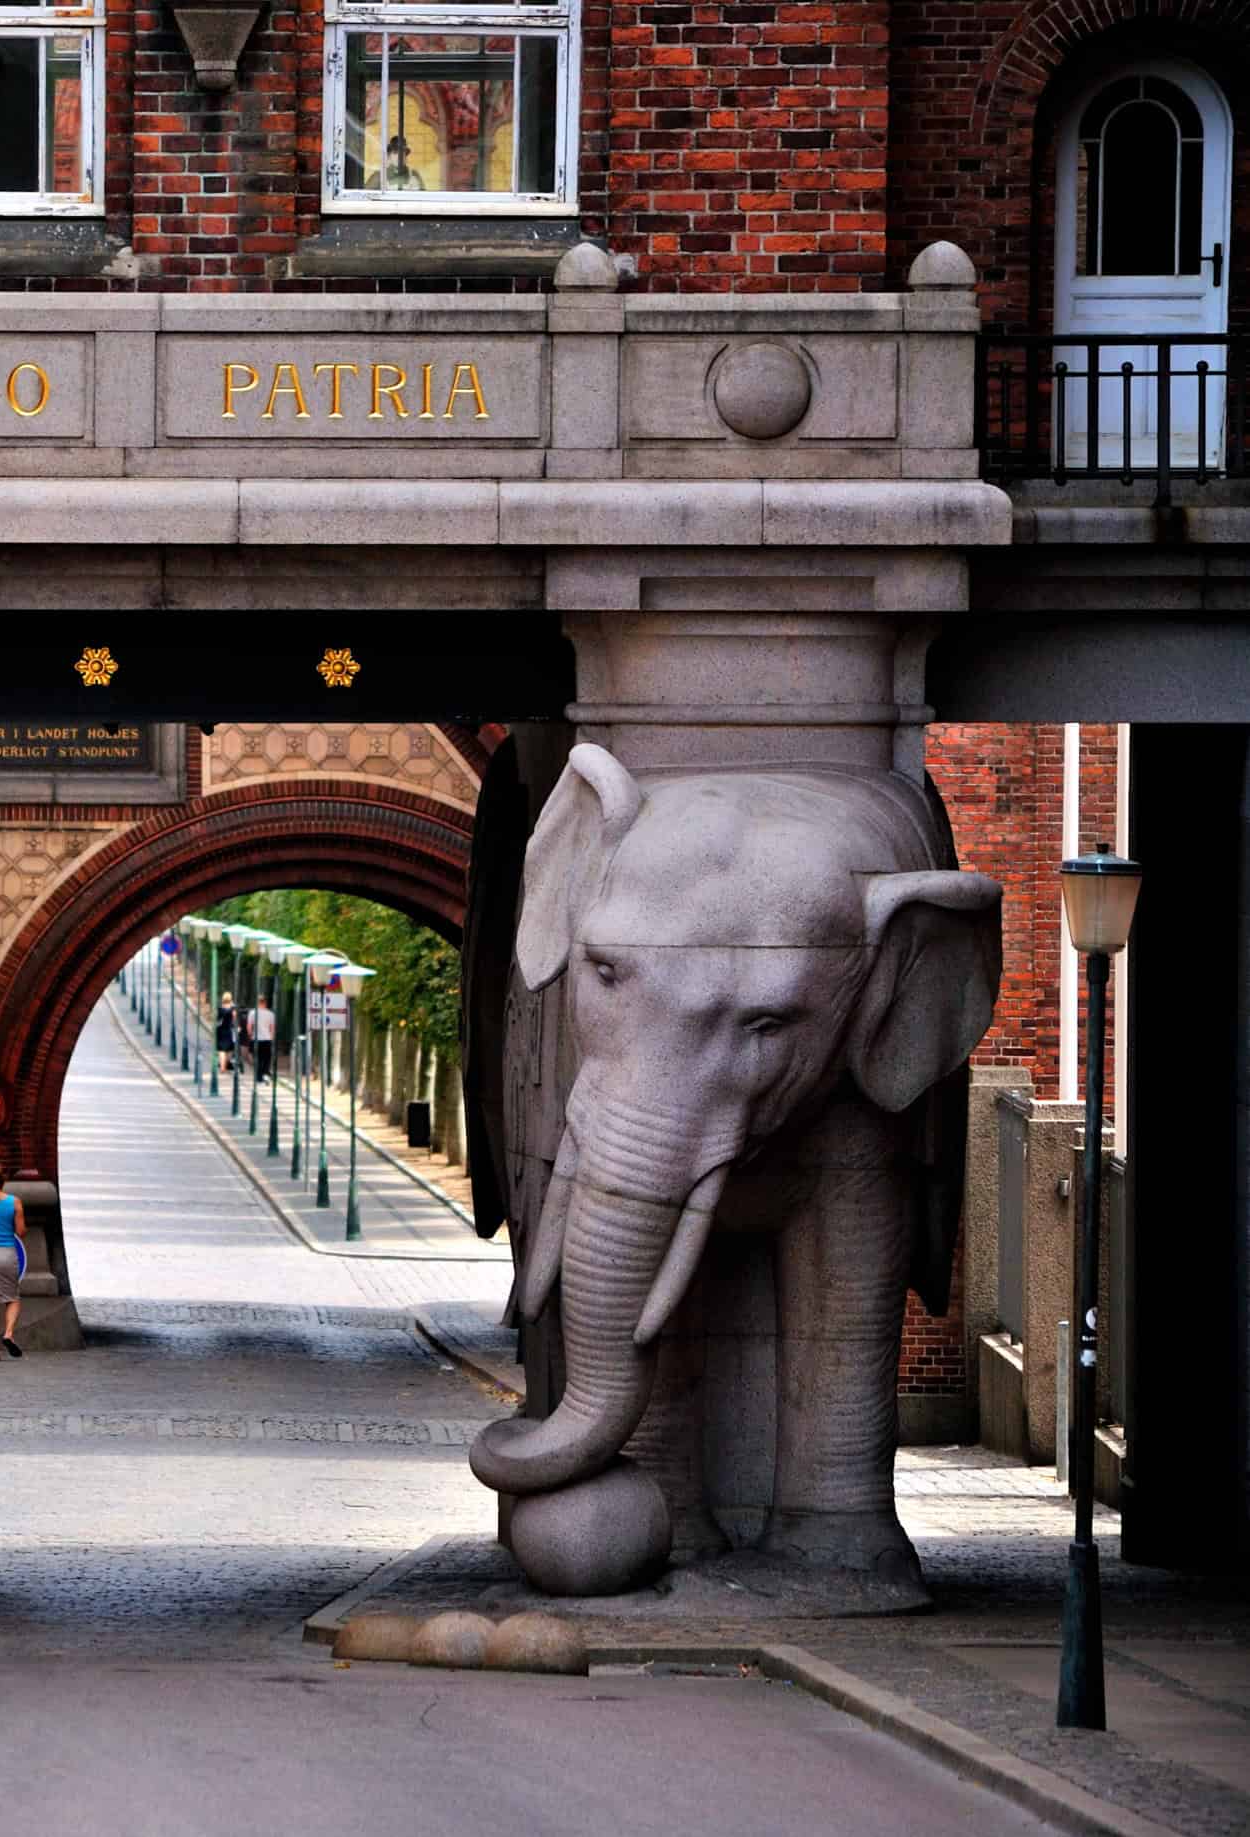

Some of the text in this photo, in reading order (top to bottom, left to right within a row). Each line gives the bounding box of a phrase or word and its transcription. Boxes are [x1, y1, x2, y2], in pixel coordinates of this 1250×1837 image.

[221, 362, 491, 419] PATRIA
[13, 727, 19, 739] I
[26, 727, 79, 739] LANDET
[58, 745, 140, 757] STANDPUNKT
